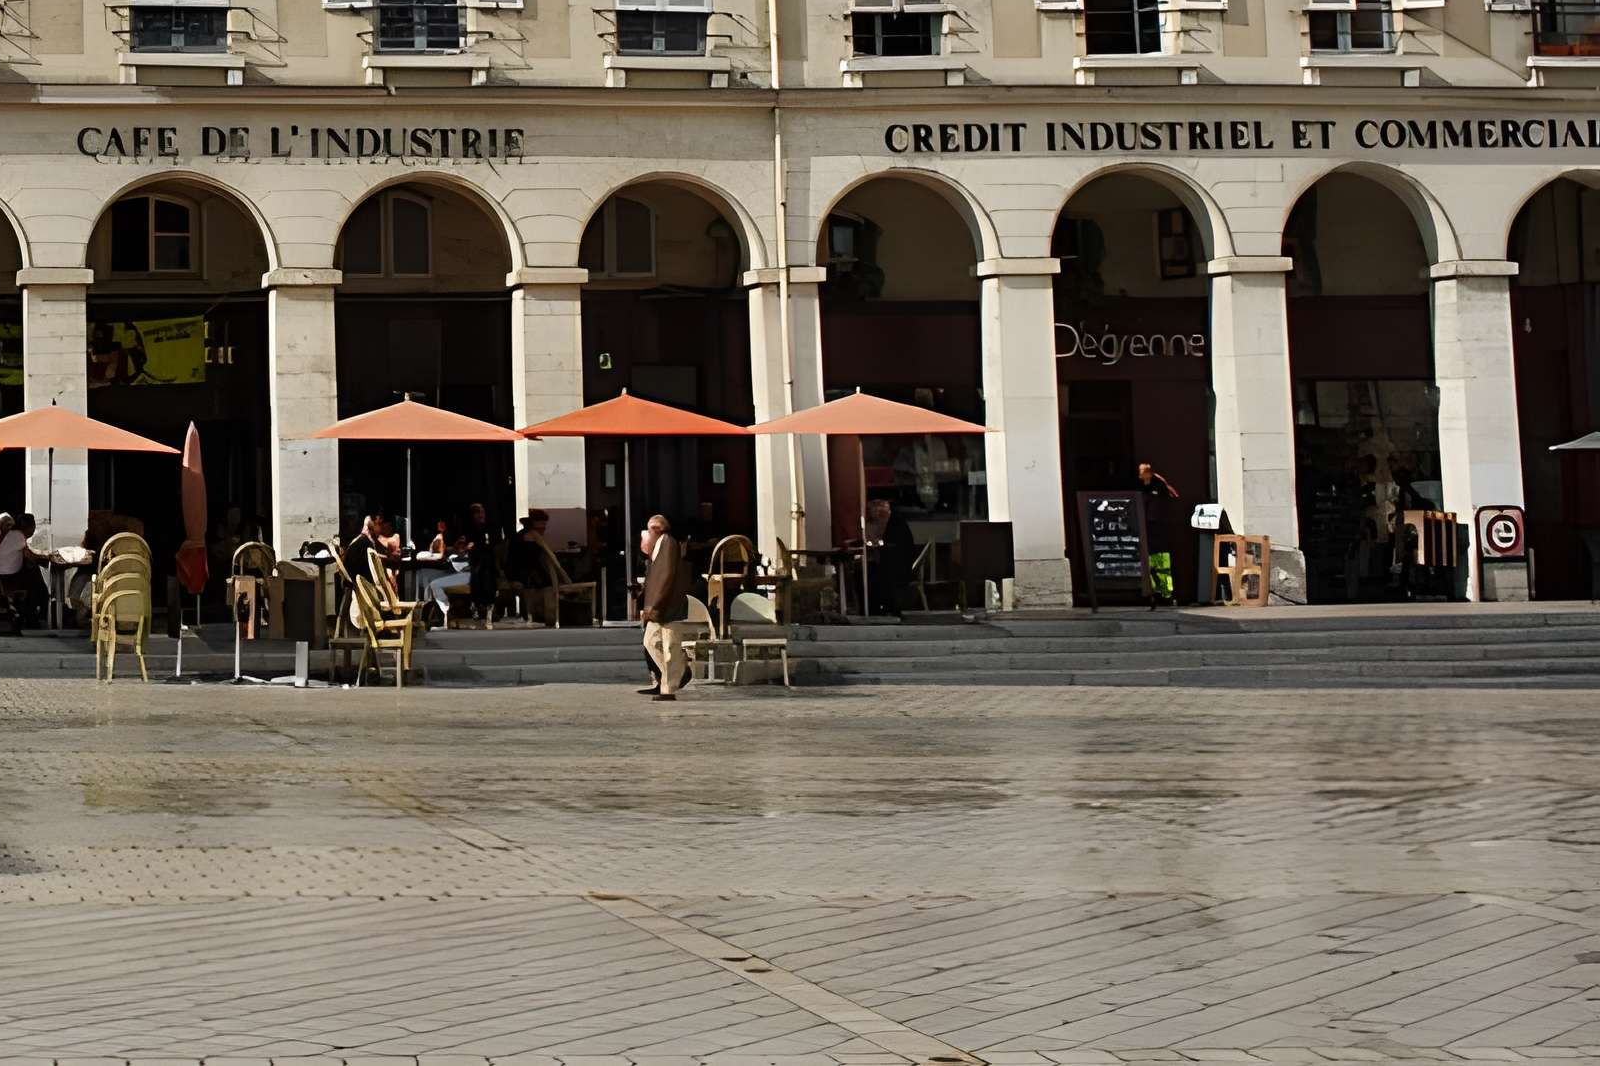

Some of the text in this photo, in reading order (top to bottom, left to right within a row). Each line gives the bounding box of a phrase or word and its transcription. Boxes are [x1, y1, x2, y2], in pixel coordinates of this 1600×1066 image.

[77, 125, 526, 159] CAFE DE L'INDUSTRIE
[885, 123, 1027, 153] CREDIT
[1046, 120, 1274, 152] INDUSTRIEL
[1291, 120, 1337, 150] ET
